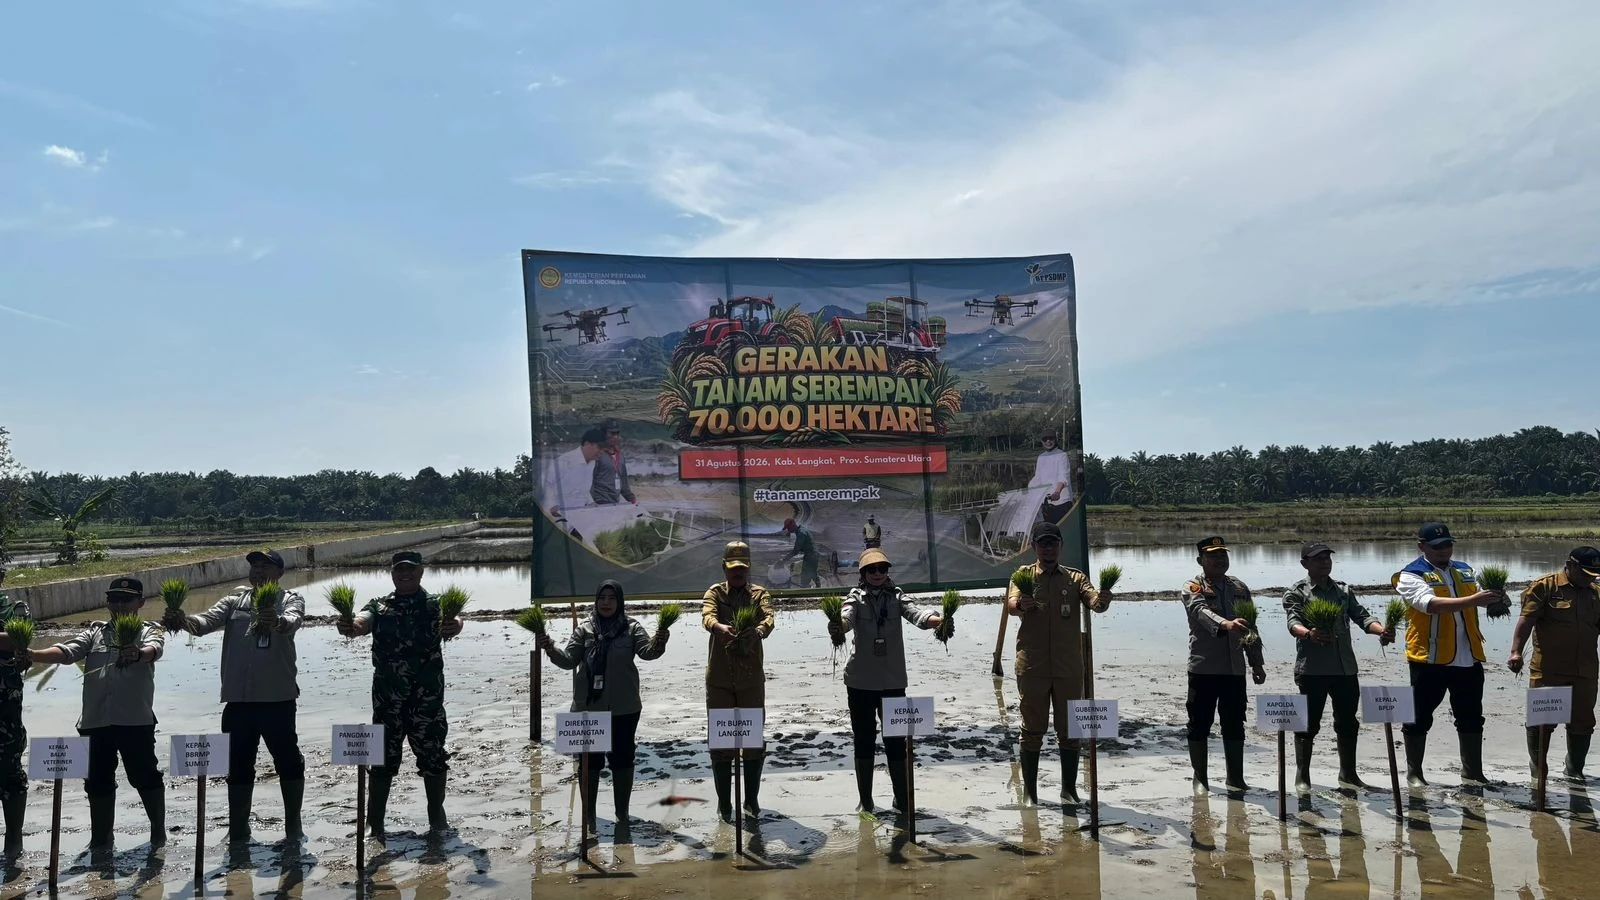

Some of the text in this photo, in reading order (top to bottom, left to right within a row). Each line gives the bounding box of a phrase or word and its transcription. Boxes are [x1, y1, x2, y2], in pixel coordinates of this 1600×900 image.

[734, 346, 888, 373] GERAKAN
[692, 375, 934, 407] TANAM SEREMPAK
[688, 405, 936, 438] 70.000 HEKTARE
[695, 454, 932, 469] 31 Agustus 2026, Kab. Langkat, Prov. Sumatera Utara
[754, 485, 880, 502] #tanamserempak
[894, 707, 919, 715] KEPALA
[559, 729, 605, 737] POLBANGTAN
